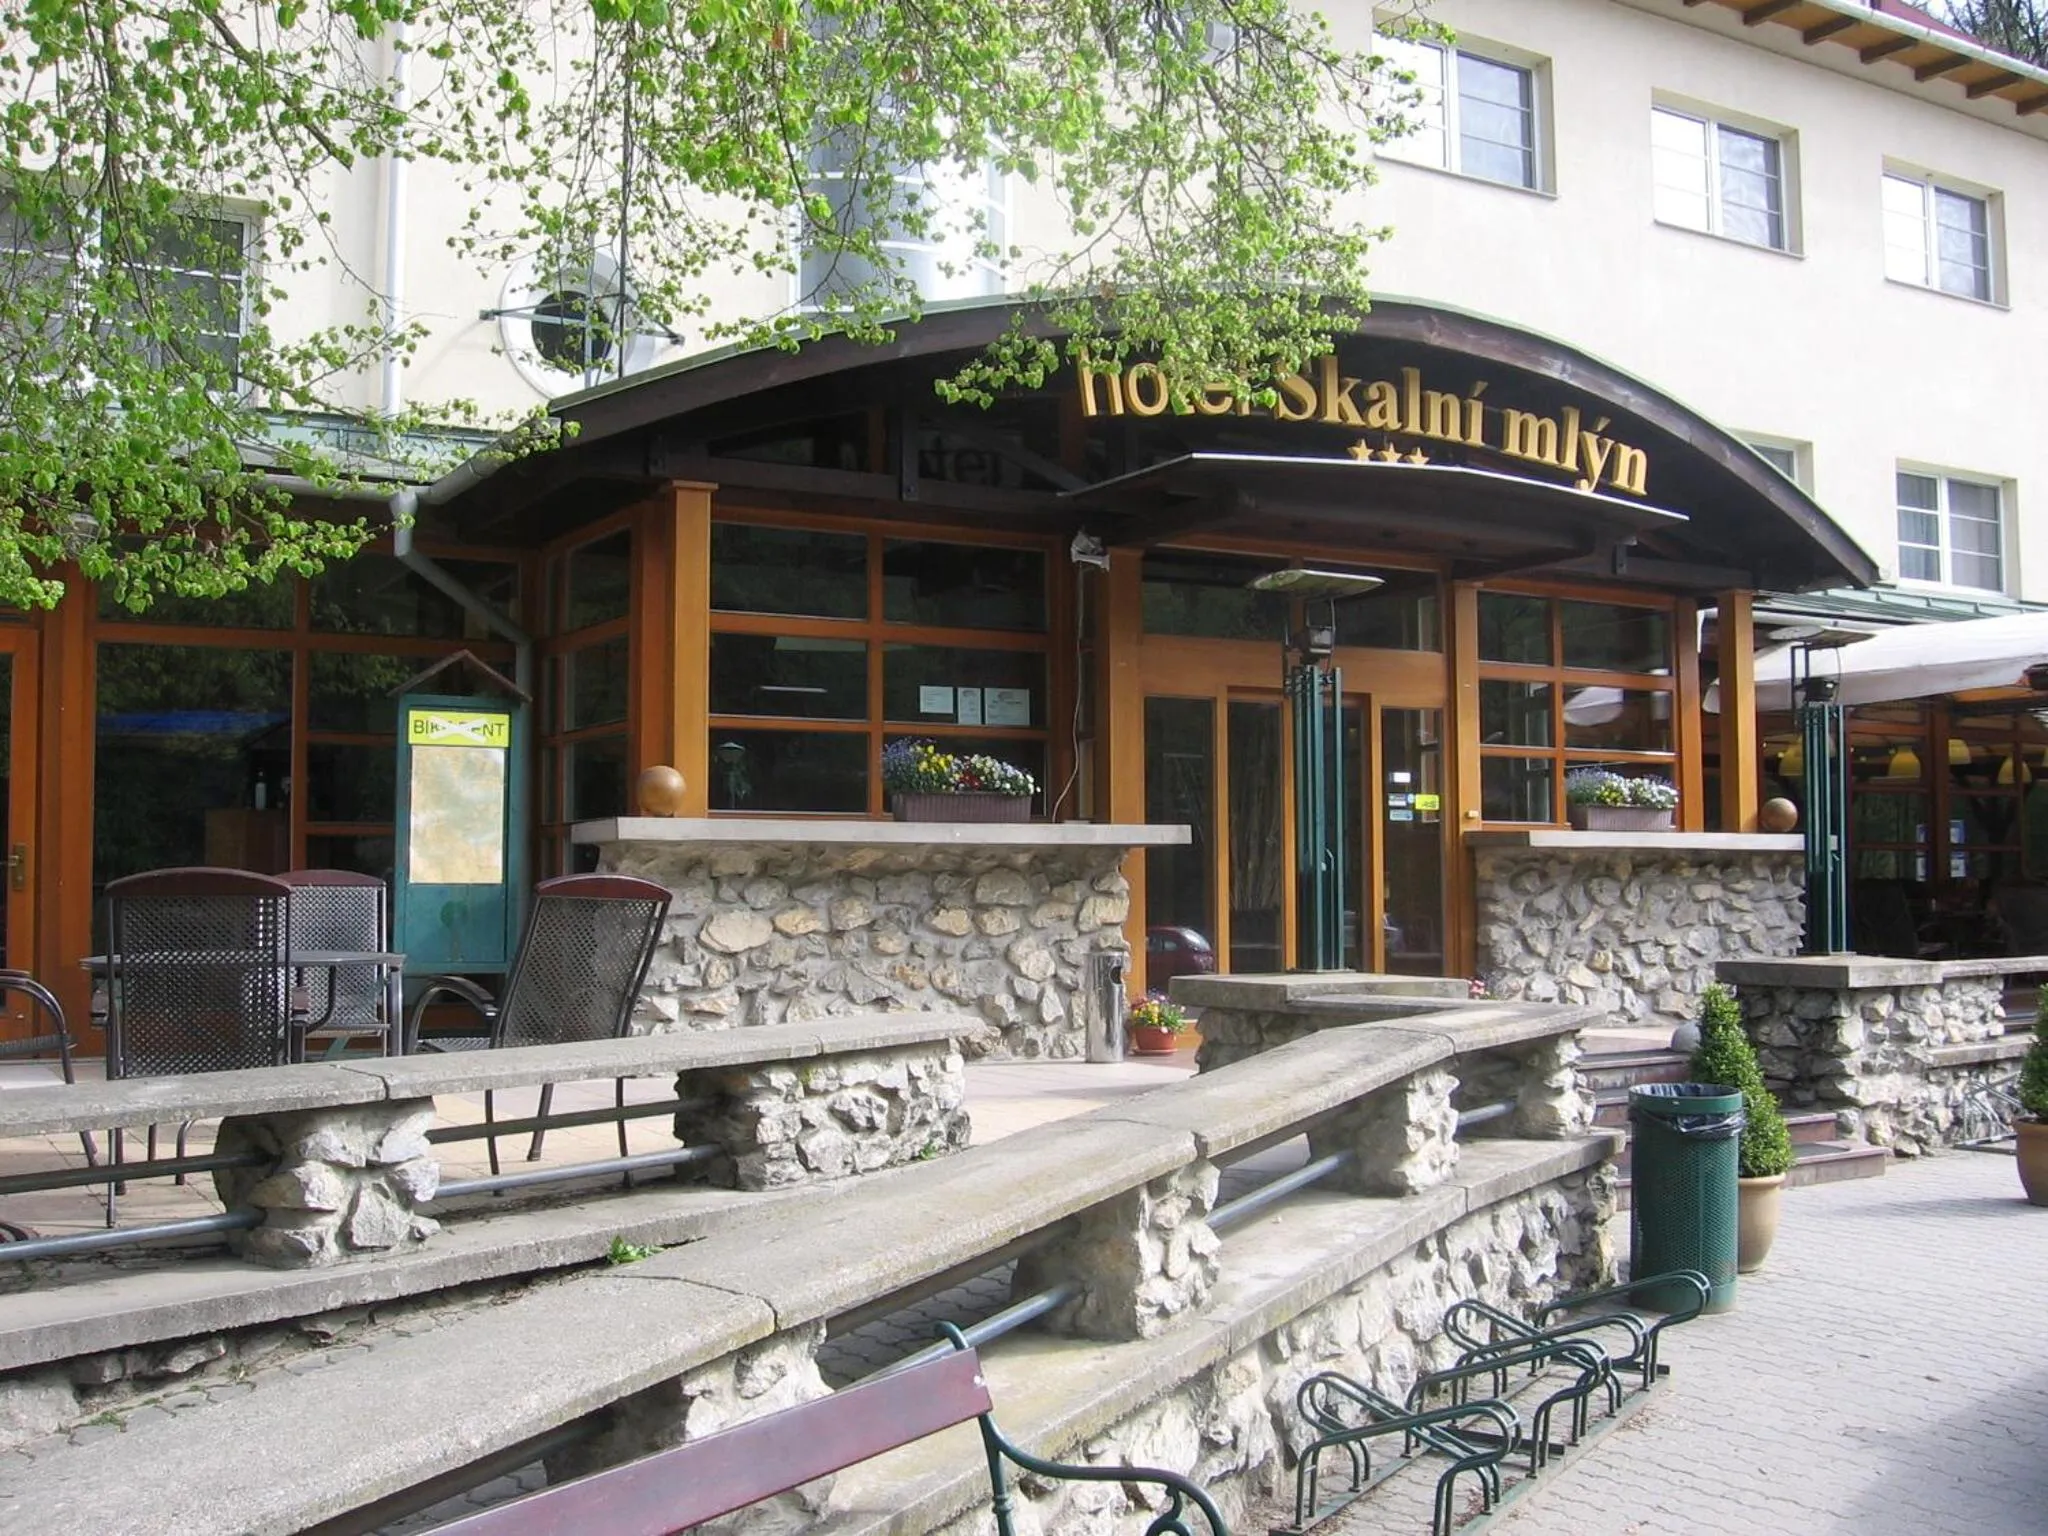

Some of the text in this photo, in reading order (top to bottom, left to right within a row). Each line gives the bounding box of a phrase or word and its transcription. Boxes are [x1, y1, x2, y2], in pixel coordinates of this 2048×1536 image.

[1076, 346, 1649, 495] hoe Skalní mlýn
